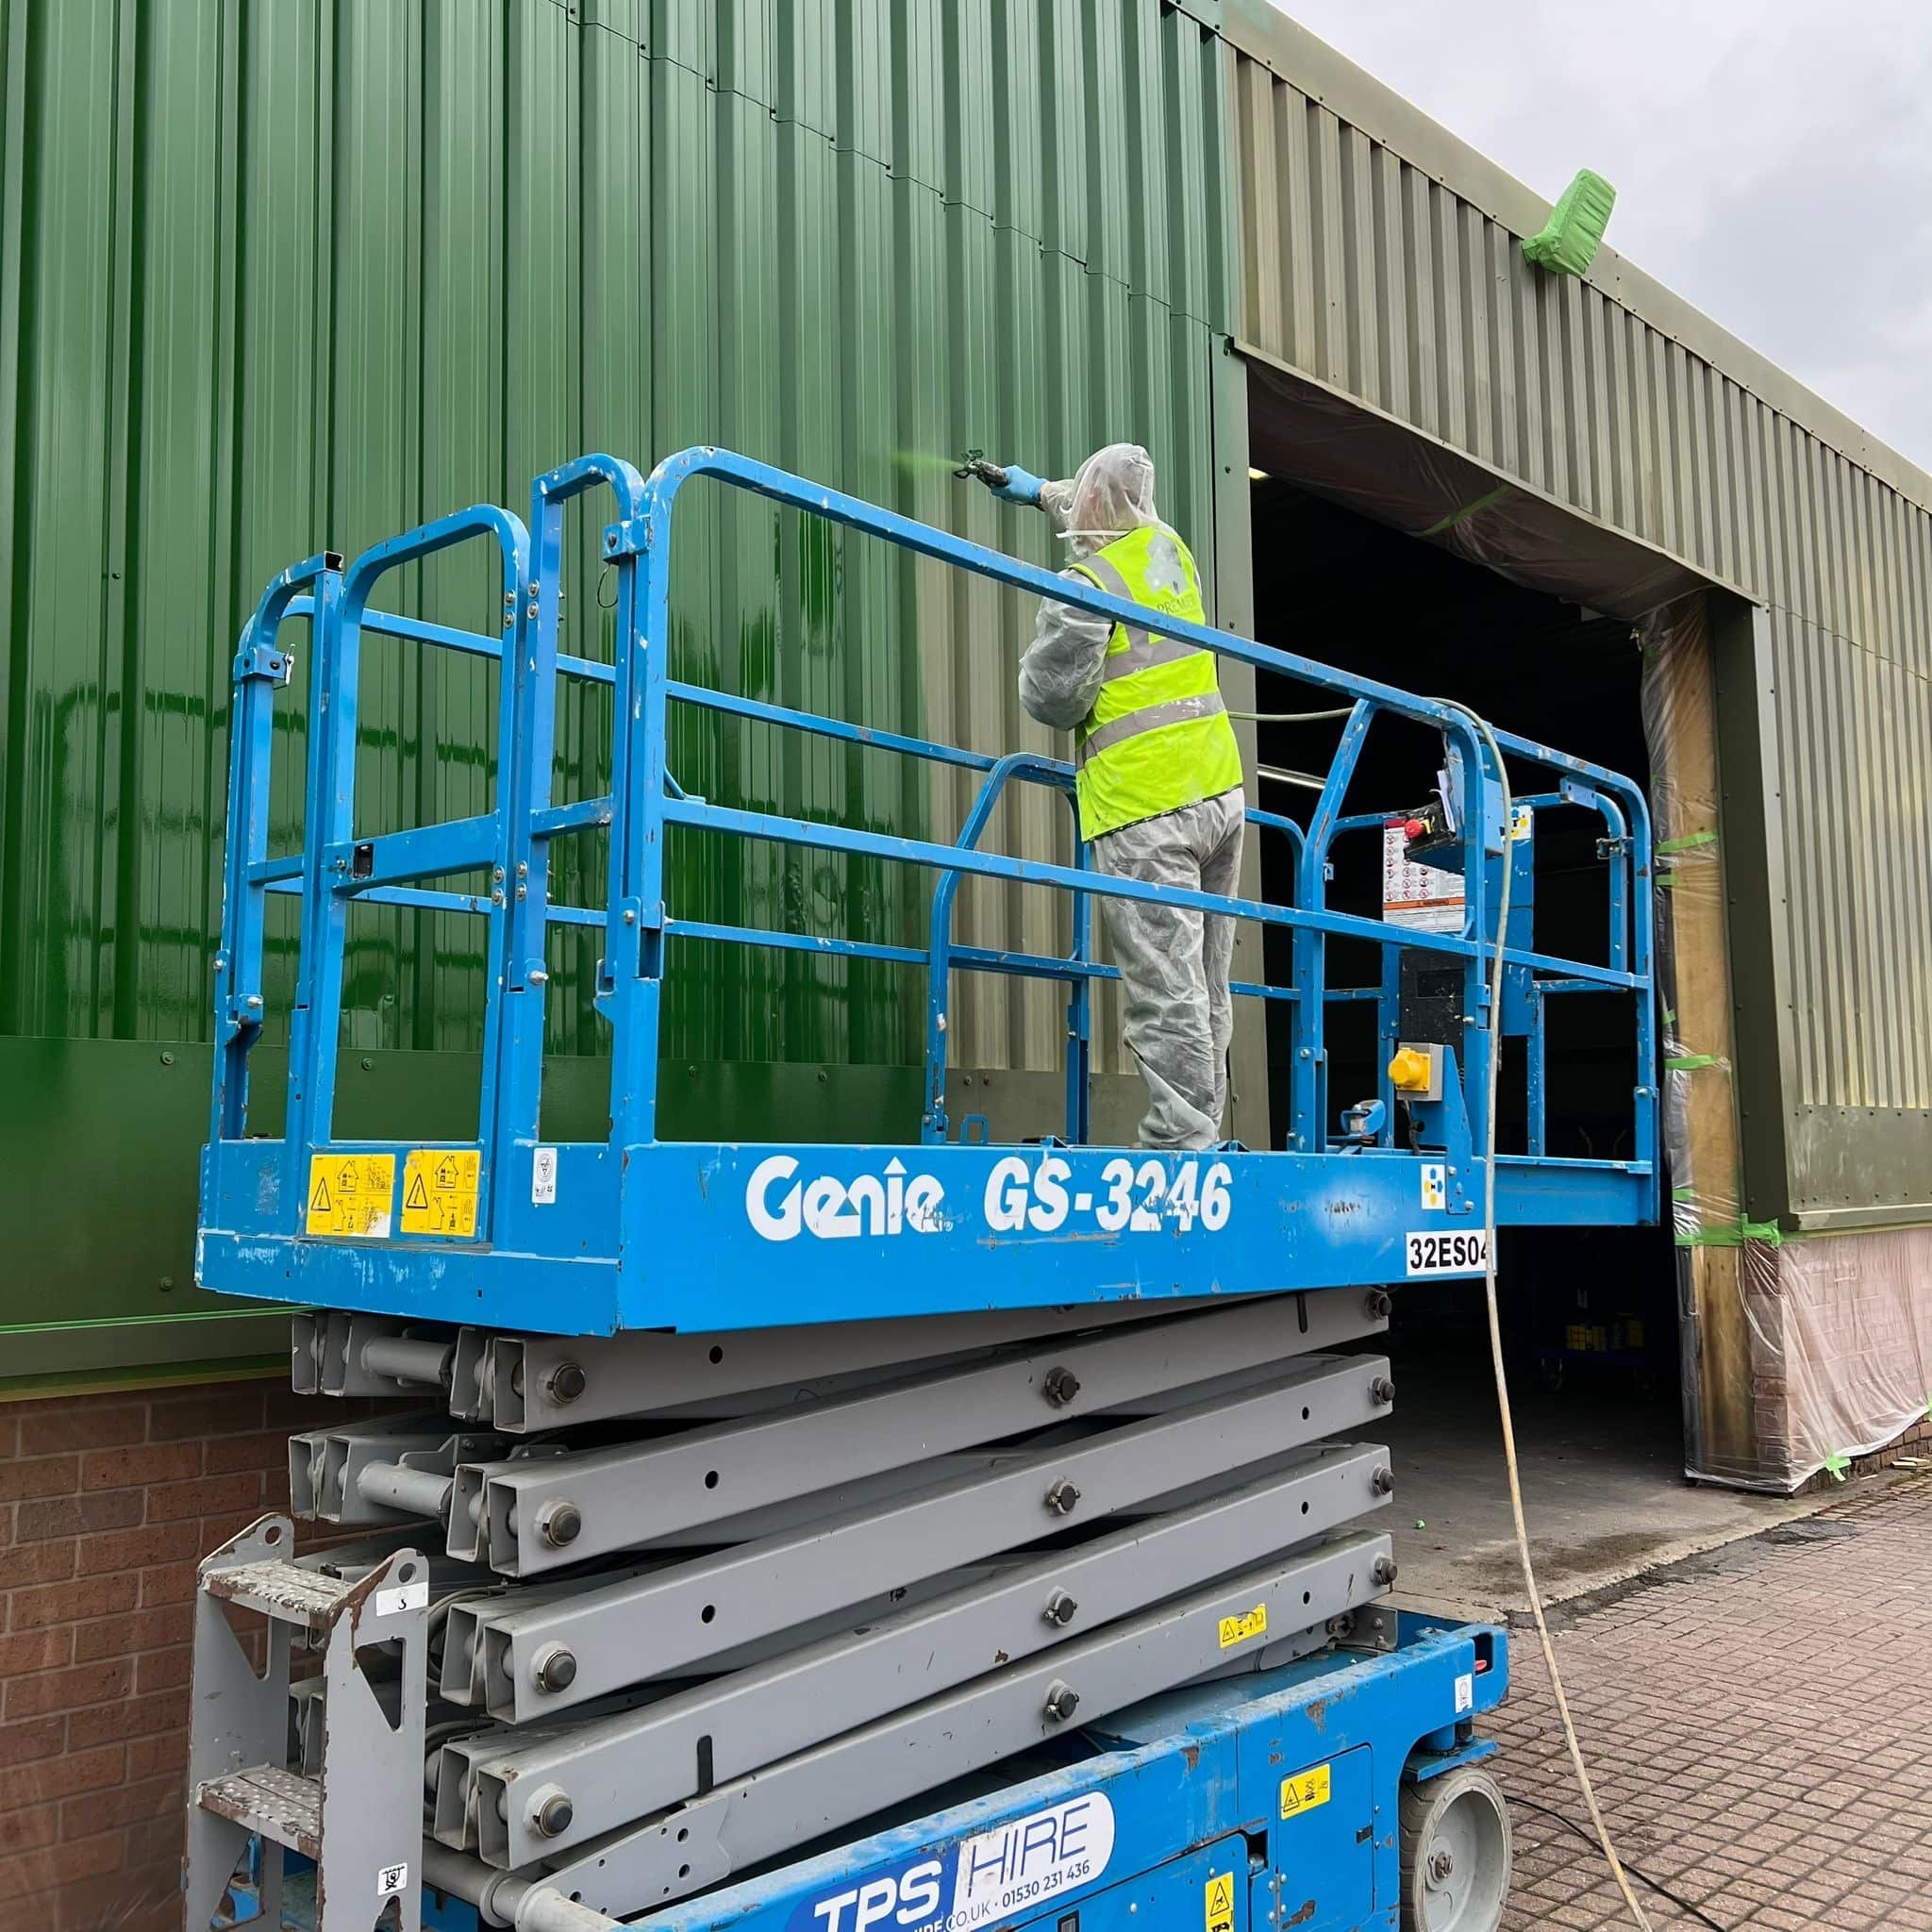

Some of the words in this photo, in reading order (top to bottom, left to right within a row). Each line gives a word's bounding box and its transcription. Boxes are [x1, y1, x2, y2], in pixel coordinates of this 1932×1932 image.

[746, 1155, 945, 1241] Genie
[984, 1156, 1233, 1232] GS-3246
[814, 1860, 942, 1932] TPS
[968, 1802, 1091, 1898] HIRE
[1002, 1881, 1040, 1908] 01530
[1043, 1871, 1063, 1891] 231
[1067, 1859, 1091, 1880] 436
